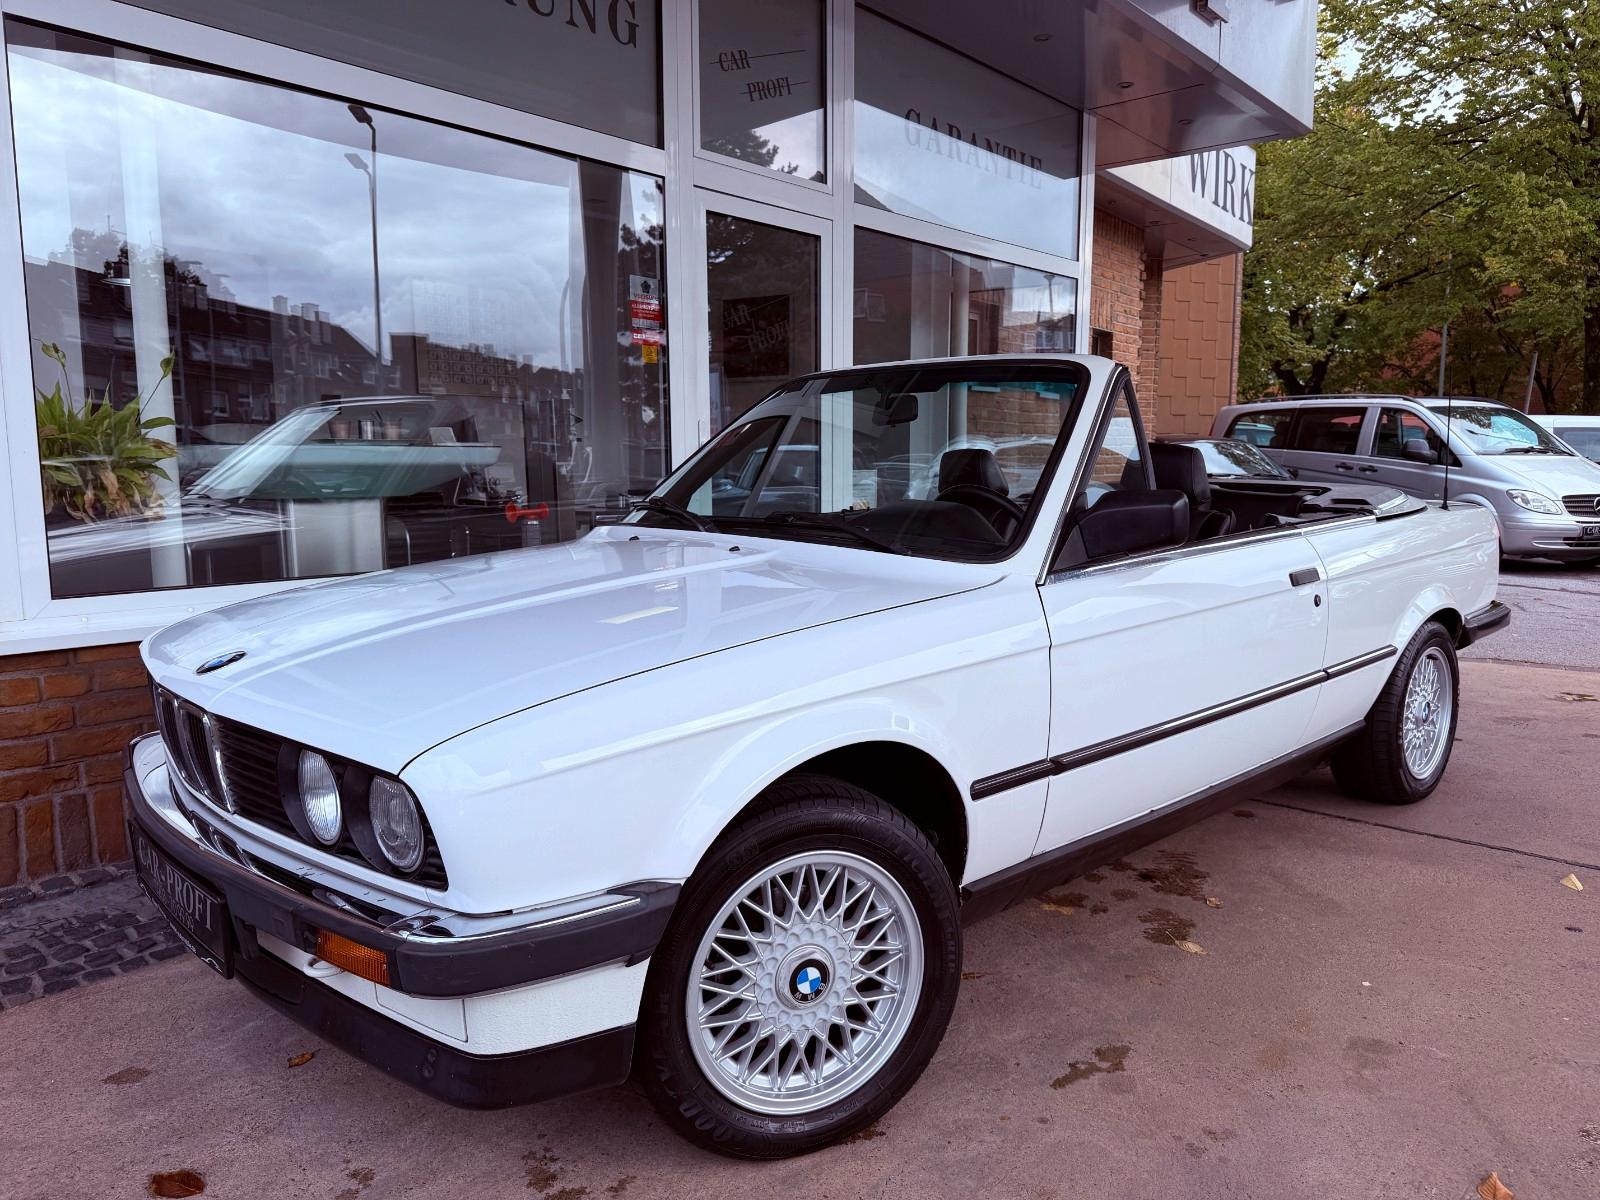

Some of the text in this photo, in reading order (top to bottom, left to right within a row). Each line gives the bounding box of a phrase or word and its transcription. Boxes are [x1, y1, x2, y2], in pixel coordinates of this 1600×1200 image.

[718, 49, 751, 72] CAR
[747, 77, 791, 102] PROFI
[904, 108, 1042, 190] GARANTIE
